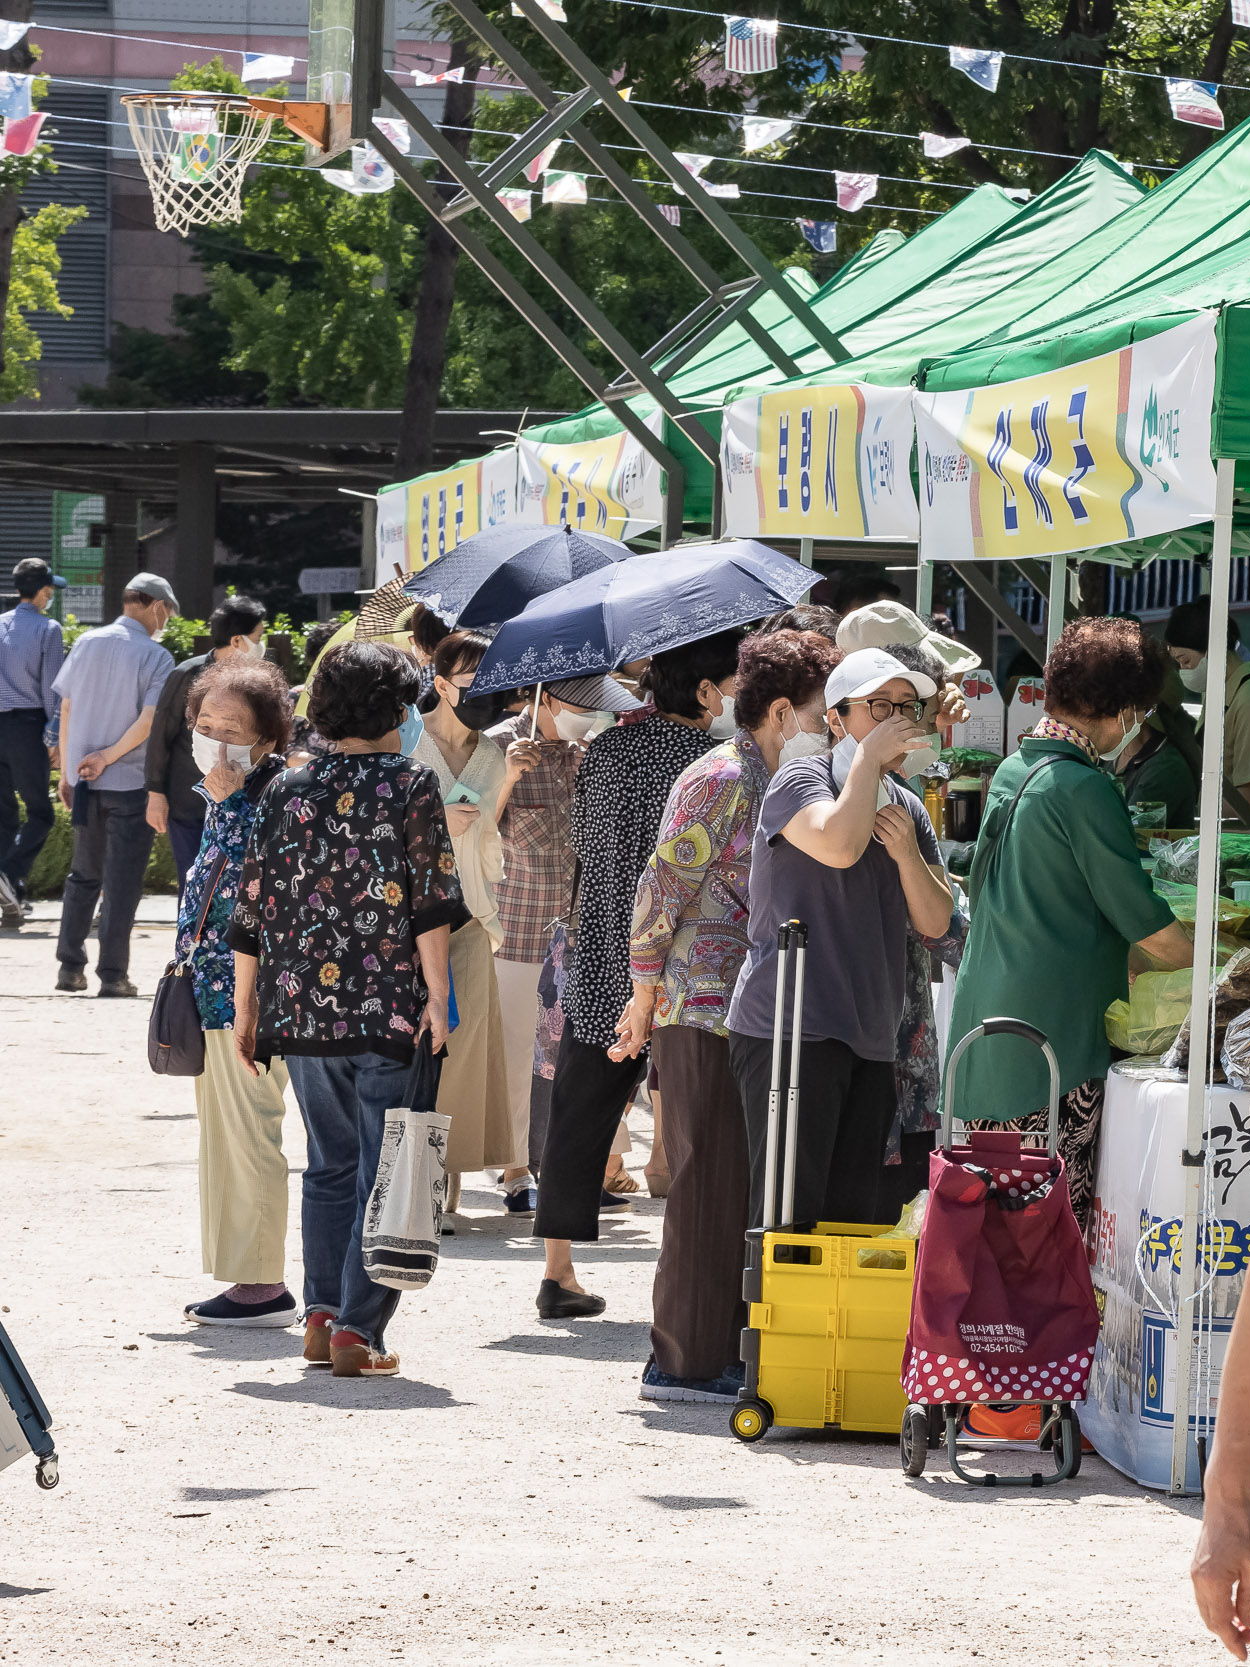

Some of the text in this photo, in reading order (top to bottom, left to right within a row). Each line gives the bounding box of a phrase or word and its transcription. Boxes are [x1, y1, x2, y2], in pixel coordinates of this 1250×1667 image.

[777, 408, 839, 512] 보령시
[986, 389, 1096, 531] 인제군
[1157, 409, 1180, 463] 인제군
